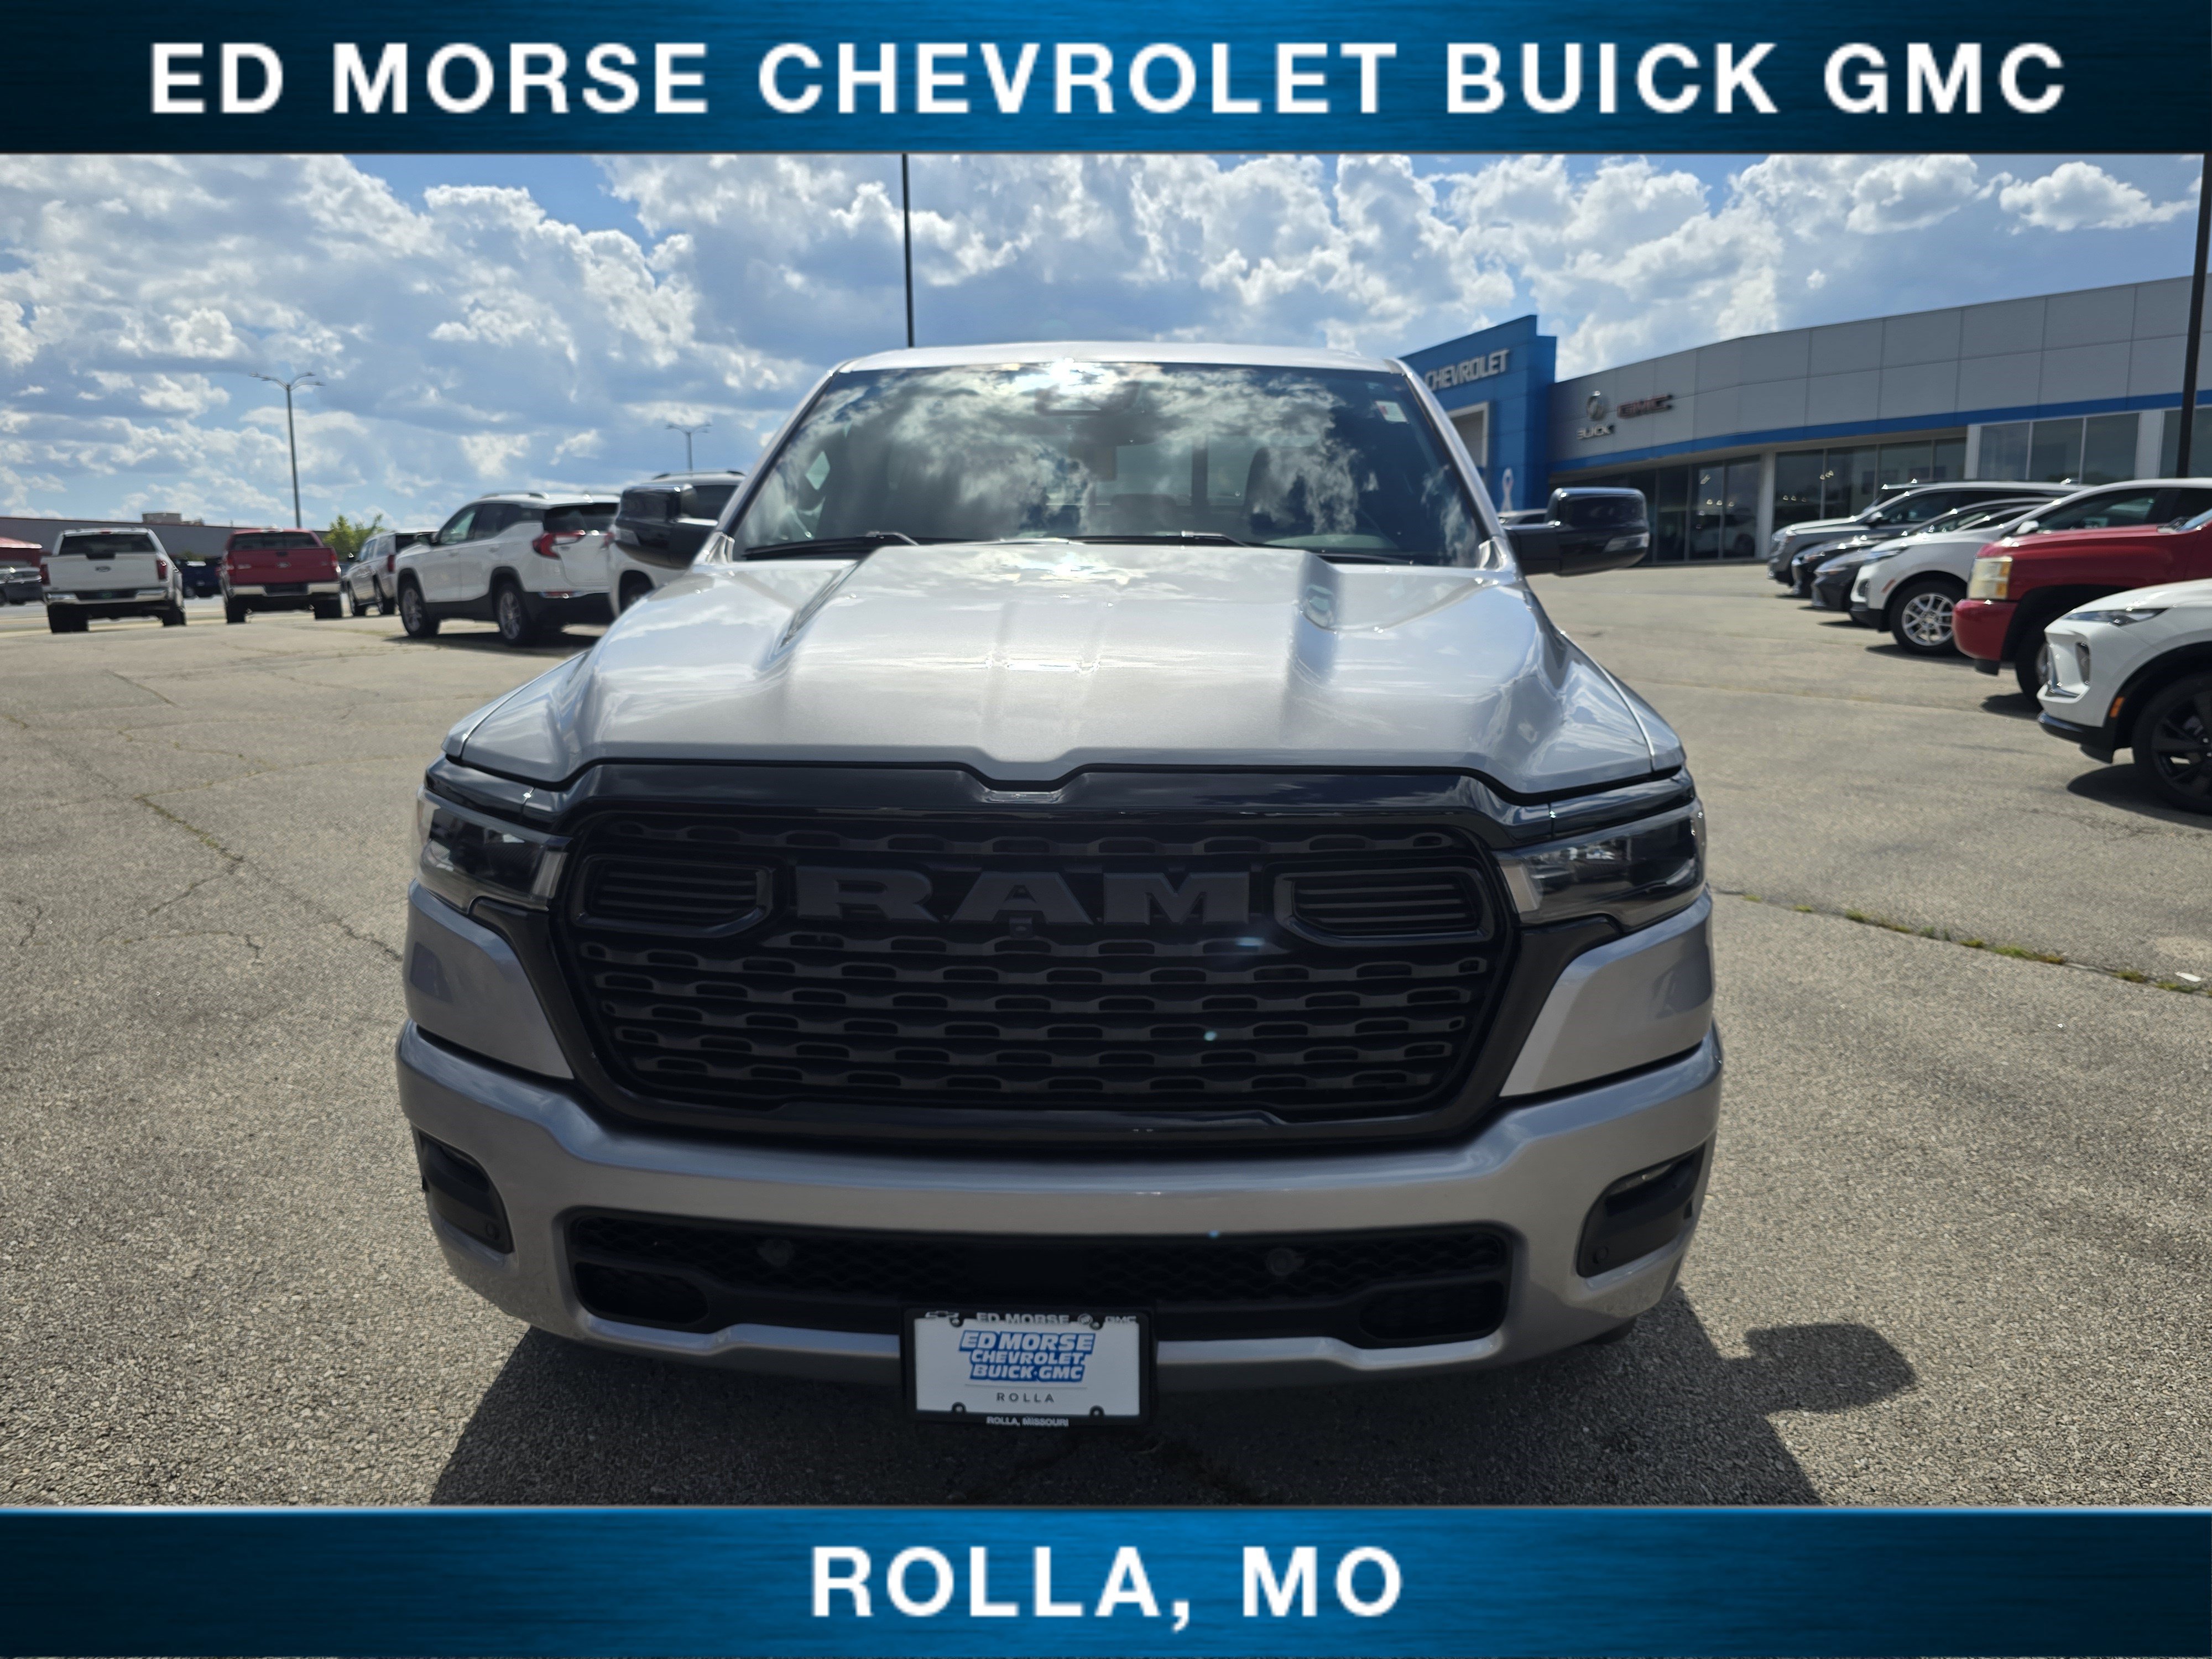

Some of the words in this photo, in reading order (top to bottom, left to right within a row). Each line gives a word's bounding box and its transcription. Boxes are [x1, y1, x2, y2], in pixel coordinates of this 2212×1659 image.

[1425, 348, 1509, 390] CHEVROLET
[795, 865, 1250, 925] RAM
[977, 1312, 1000, 1323] ED
[1005, 1313, 1070, 1324] MORSE
[961, 1331, 996, 1349] ED
[998, 1333, 1094, 1352] MORSE
[997, 1392, 1055, 1403] ROLLA
